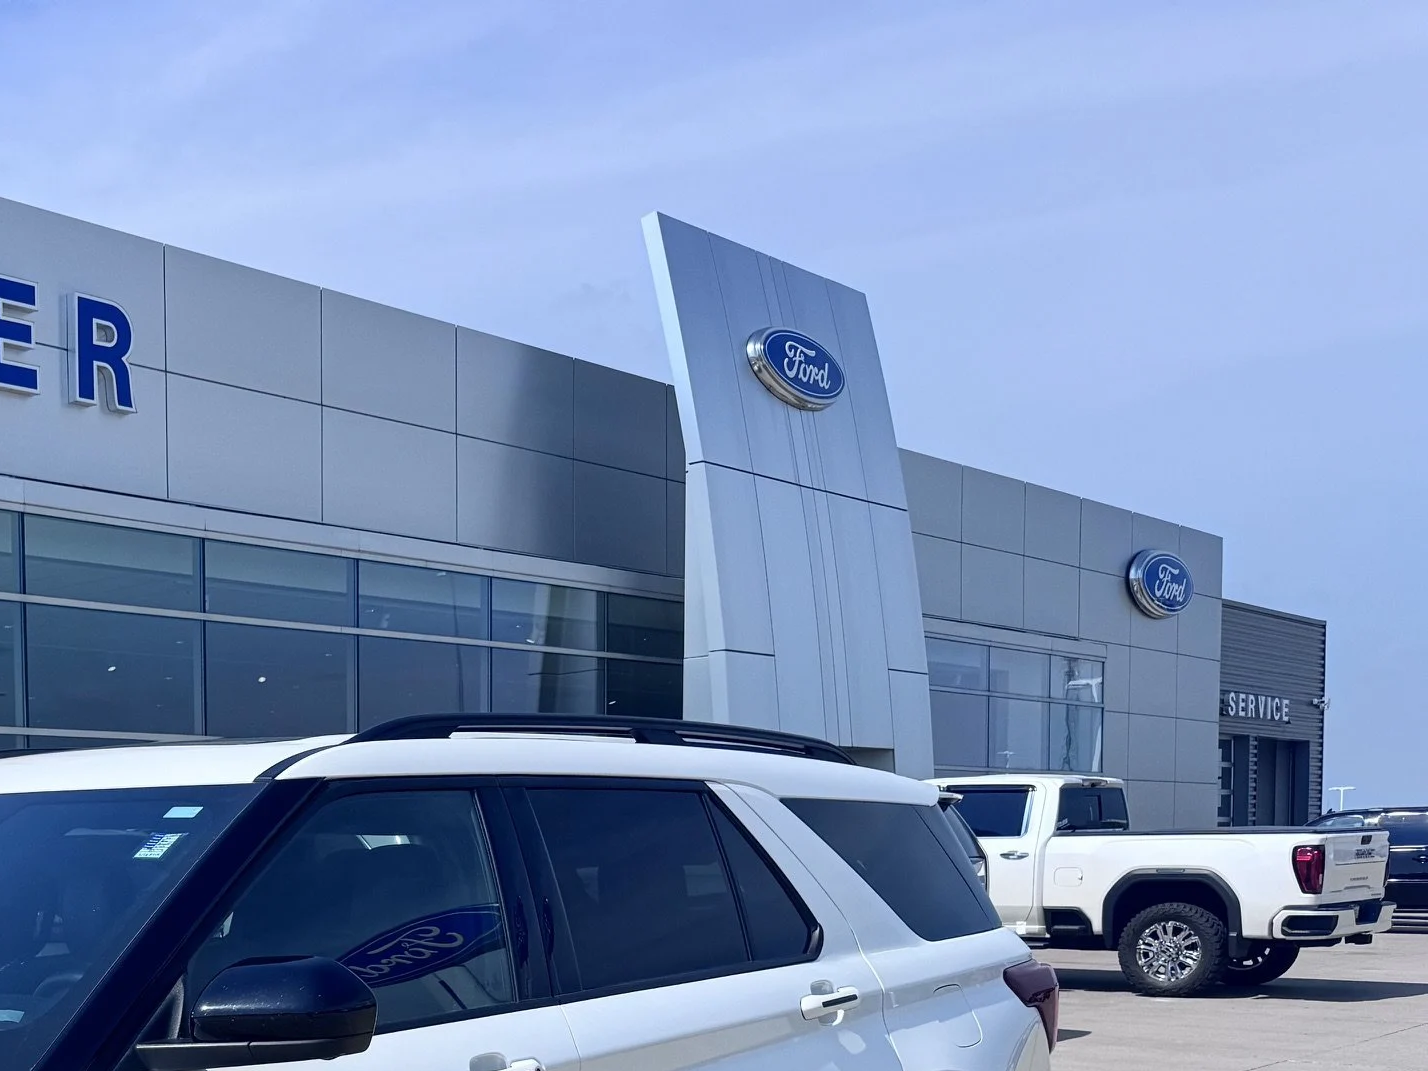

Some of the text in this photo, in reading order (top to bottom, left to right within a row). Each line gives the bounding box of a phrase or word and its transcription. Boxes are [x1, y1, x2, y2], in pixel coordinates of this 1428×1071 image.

[783, 340, 831, 390] Ford
[1154, 563, 1187, 602] Ford
[1228, 691, 1290, 722] SERVICE
